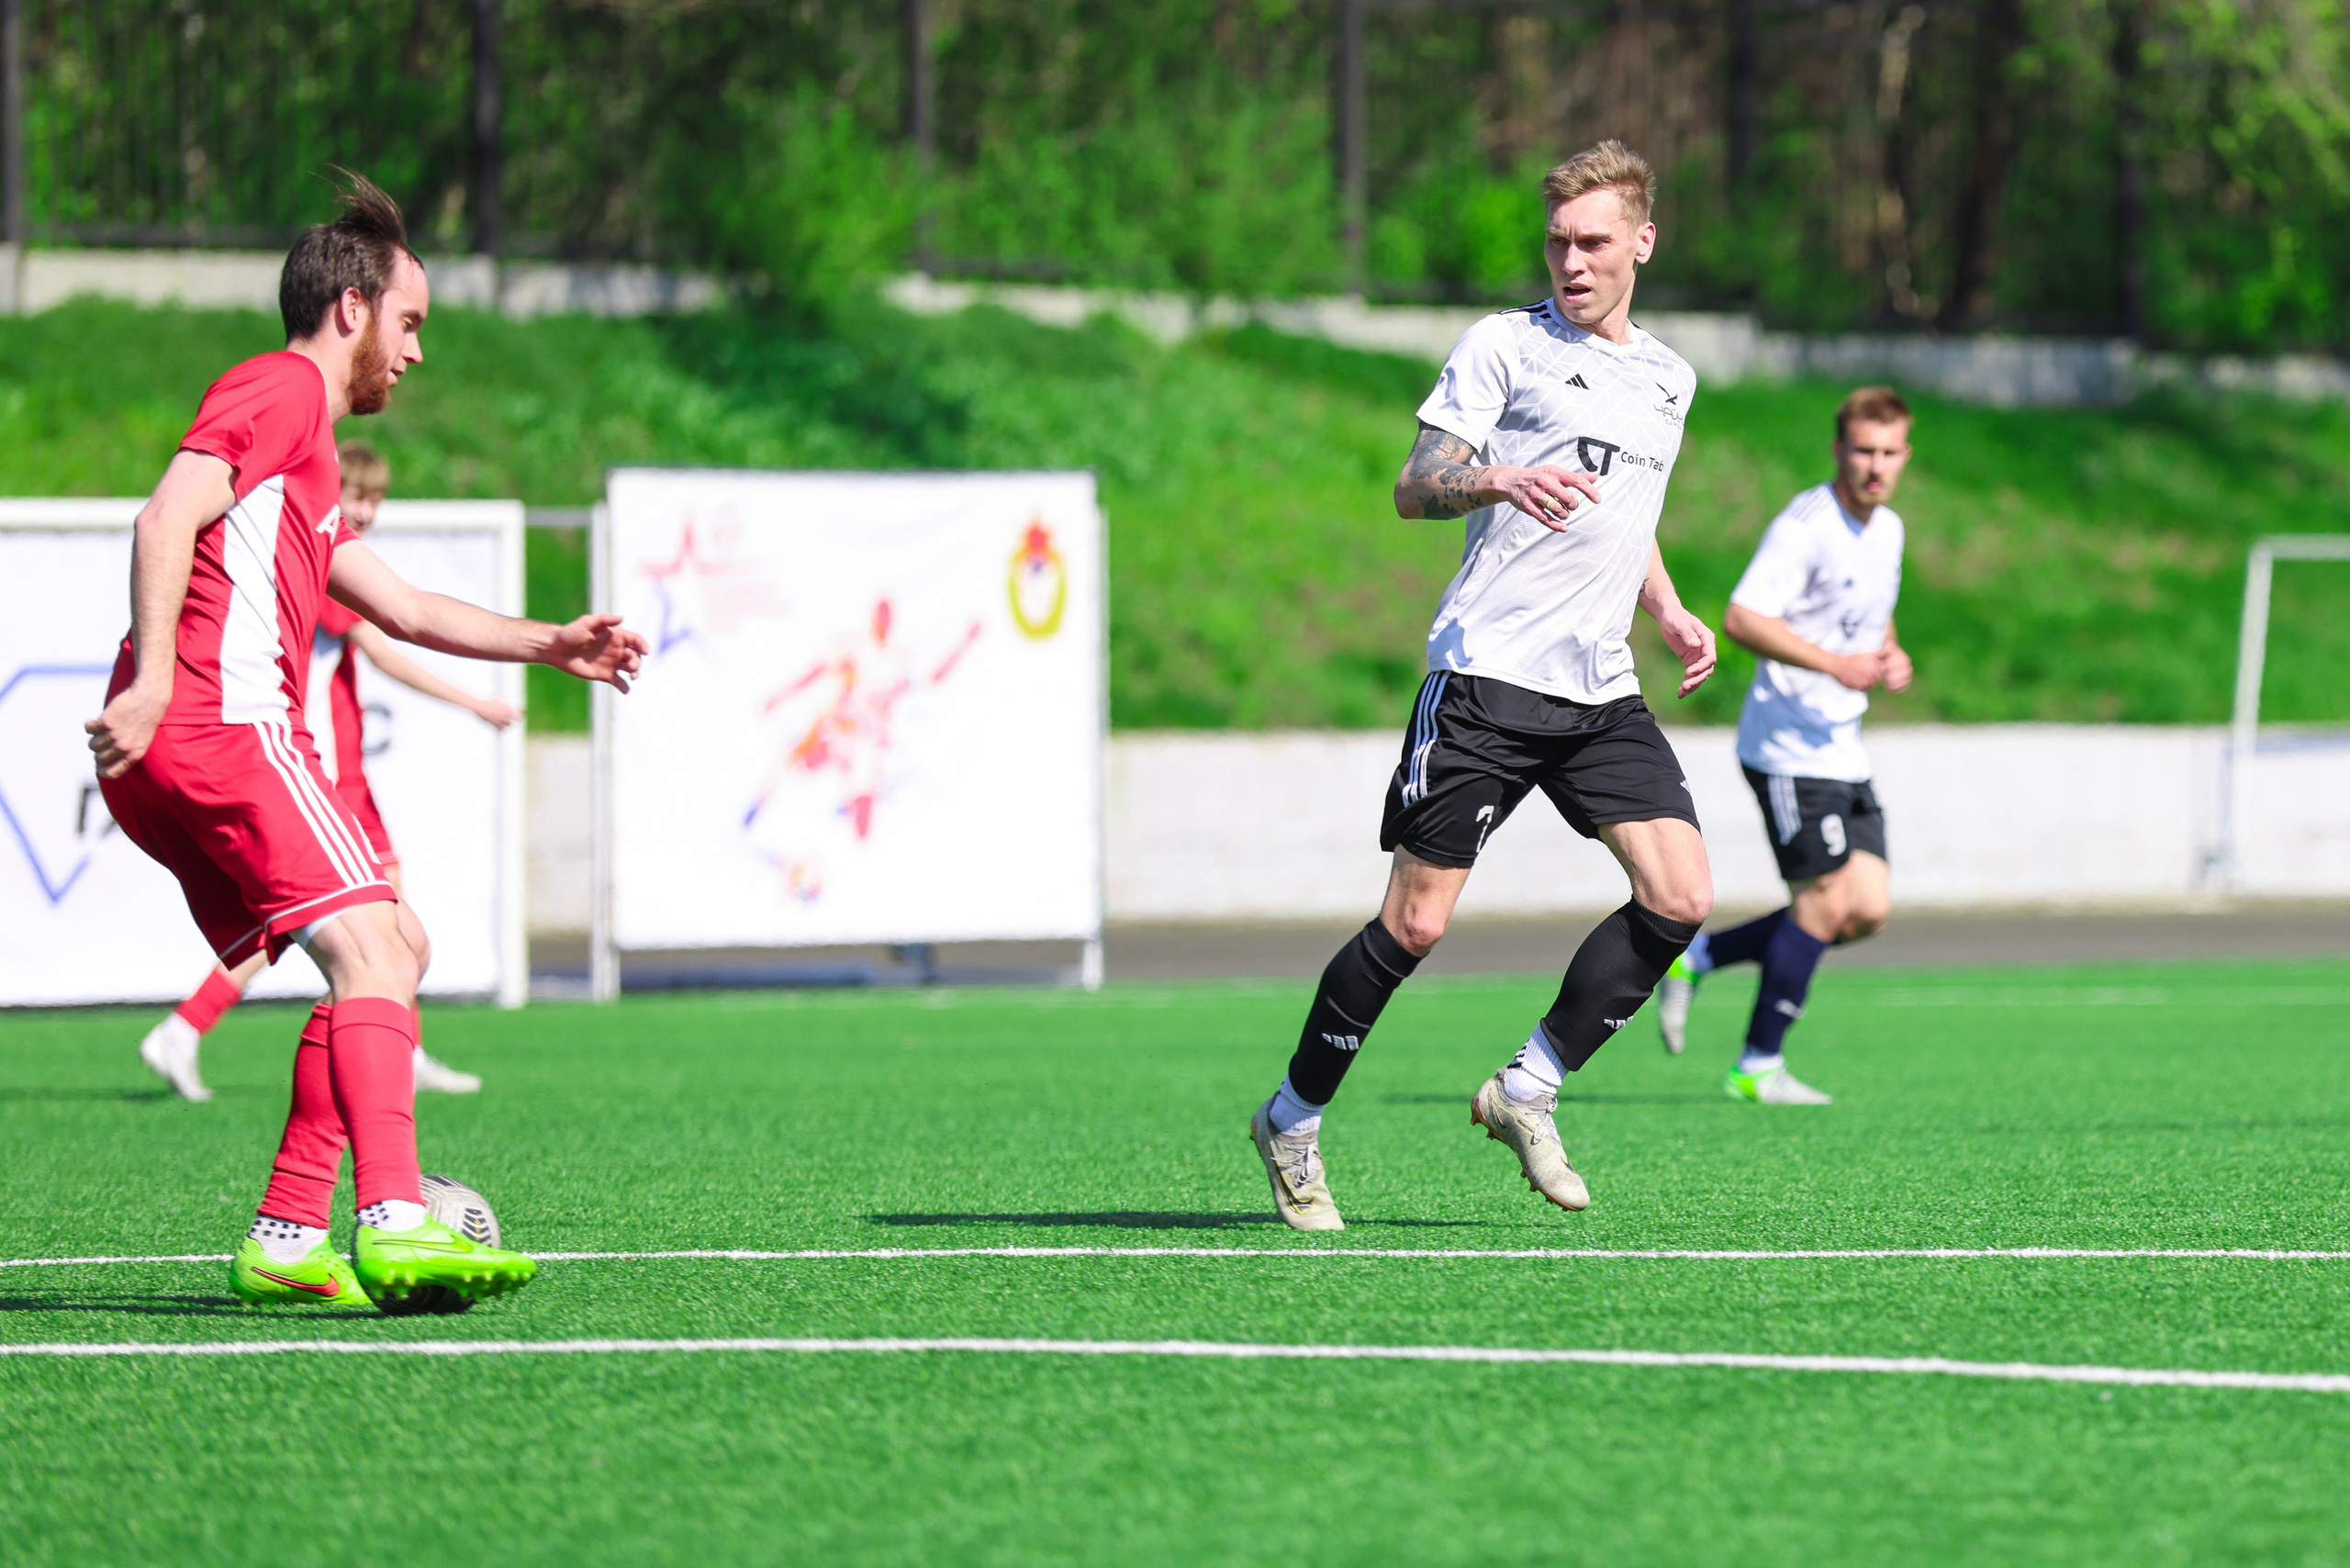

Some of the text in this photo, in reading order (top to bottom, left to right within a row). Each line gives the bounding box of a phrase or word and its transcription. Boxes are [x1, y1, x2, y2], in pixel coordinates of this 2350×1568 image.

[1620, 452, 1646, 466] Coin
[1649, 457, 1665, 472] Tab
[1819, 812, 1848, 857] 9
